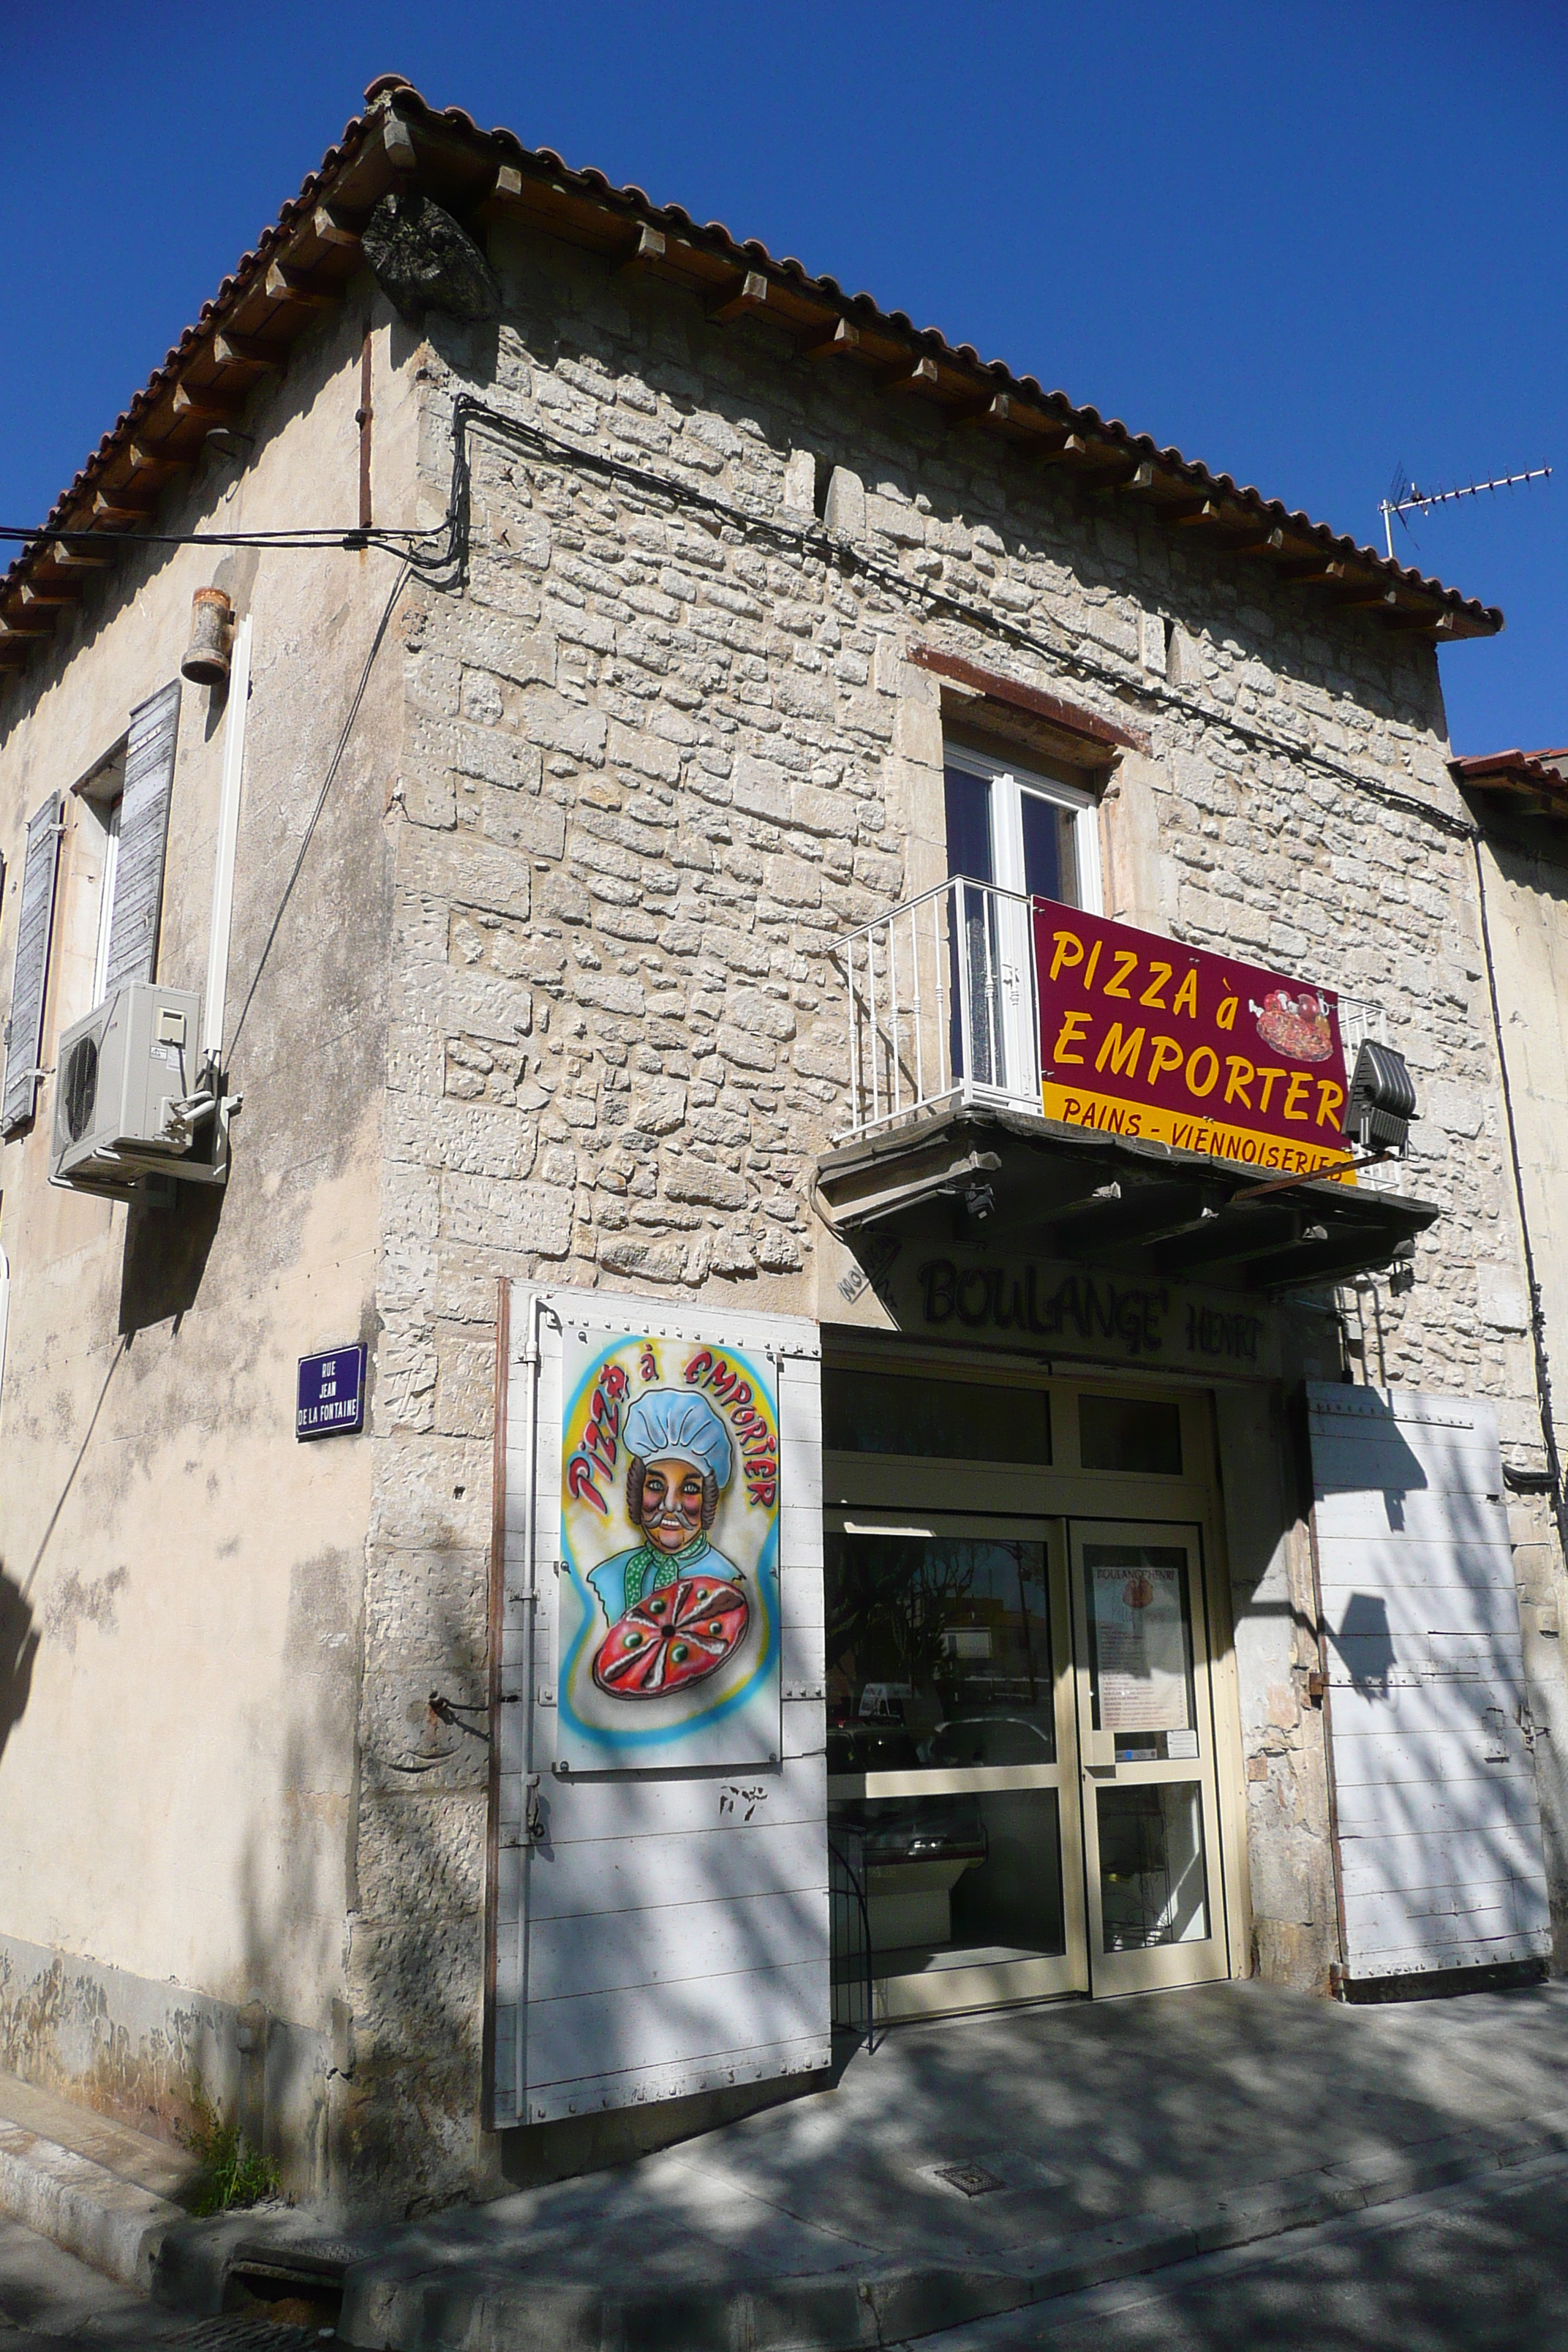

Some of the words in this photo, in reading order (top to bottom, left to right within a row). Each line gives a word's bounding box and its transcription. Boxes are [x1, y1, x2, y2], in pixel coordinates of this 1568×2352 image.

[1049, 931, 1198, 1019] PIZZA
[1215, 976, 1239, 1031] à
[1053, 1011, 1343, 1132] EMPORTER
[1062, 1098, 1142, 1137] PAINS
[322, 1361, 336, 1378] RUE
[319, 1382, 336, 1399] JEAN
[298, 1409, 307, 1425] DE
[308, 1406, 317, 1424] LA
[320, 1399, 357, 1422] FONTAINE
[639, 1343, 660, 1382] à
[683, 1351, 777, 1508] EMPORTER
